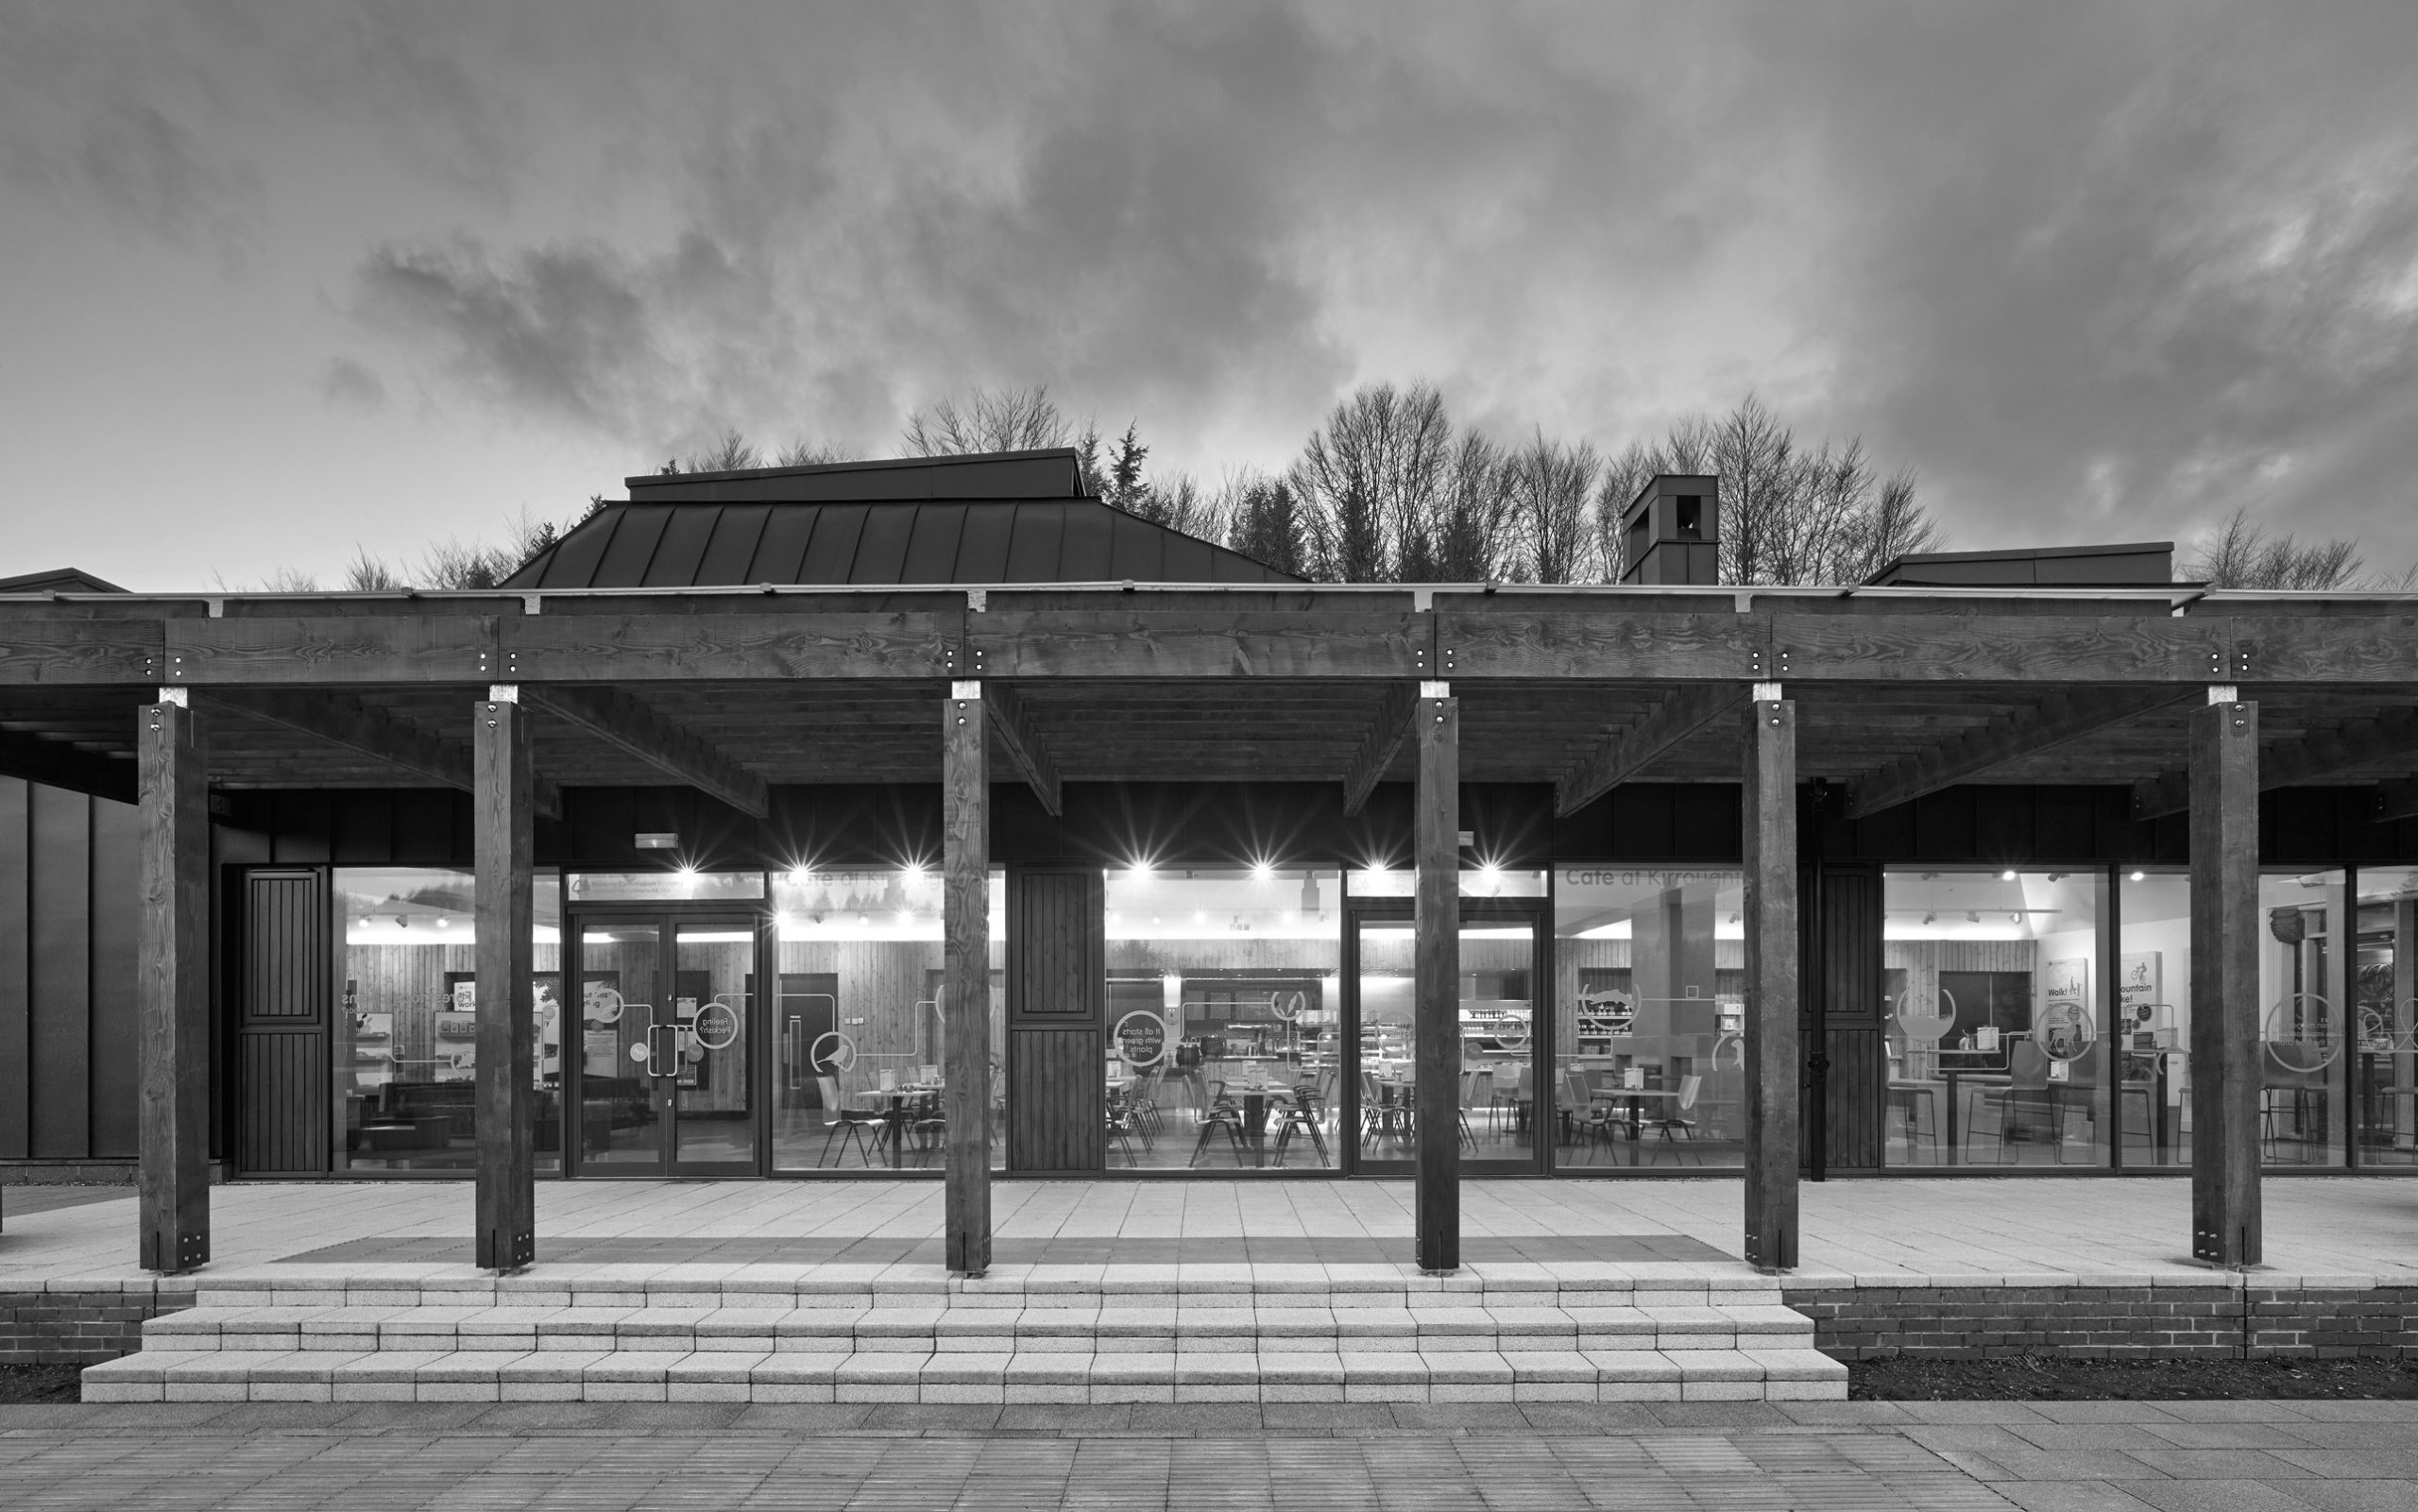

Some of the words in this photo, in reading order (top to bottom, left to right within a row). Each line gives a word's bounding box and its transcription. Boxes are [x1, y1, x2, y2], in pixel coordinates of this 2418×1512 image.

[1648, 868, 1741, 891] Kirrought
[2048, 988, 2068, 996] Walk!
[2120, 983, 2153, 993] ountain
